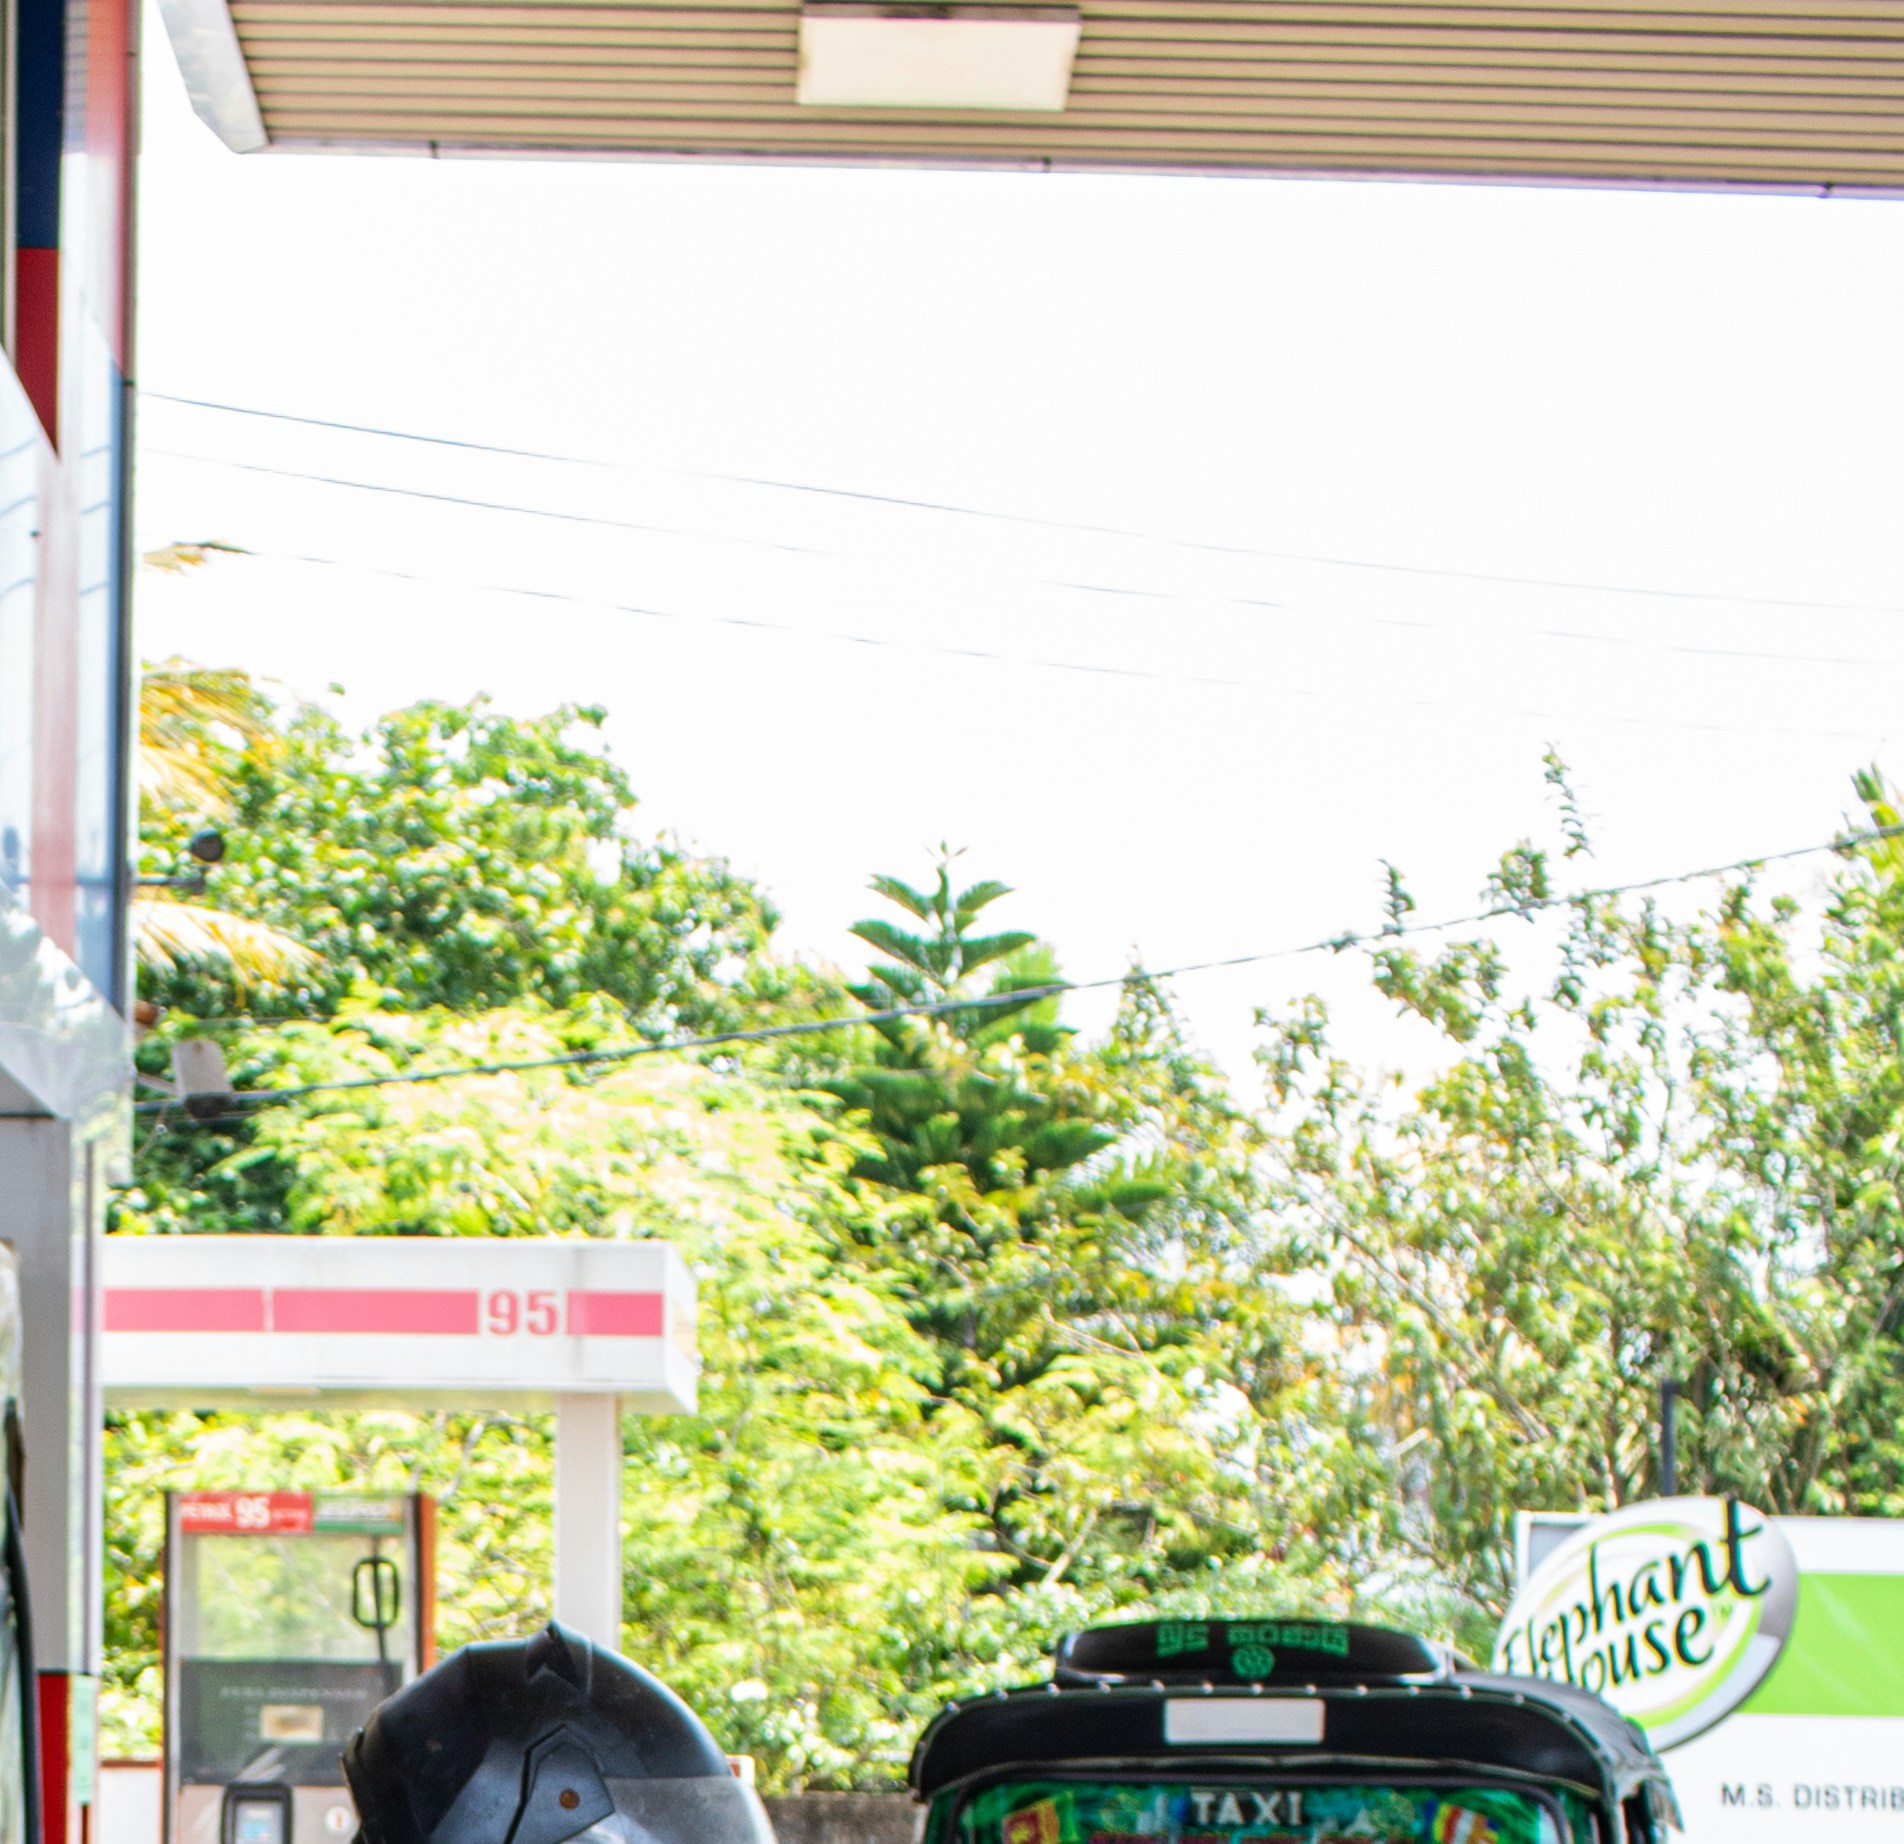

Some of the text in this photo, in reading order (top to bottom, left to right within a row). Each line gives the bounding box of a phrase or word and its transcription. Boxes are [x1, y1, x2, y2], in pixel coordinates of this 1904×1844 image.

[487, 1287, 560, 1336] 95
[235, 1497, 270, 1529] 95
[1546, 1606, 1715, 1696] ouse
[1191, 1791, 1303, 1826] TAXI
[1720, 1783, 1780, 1809] M.S.
